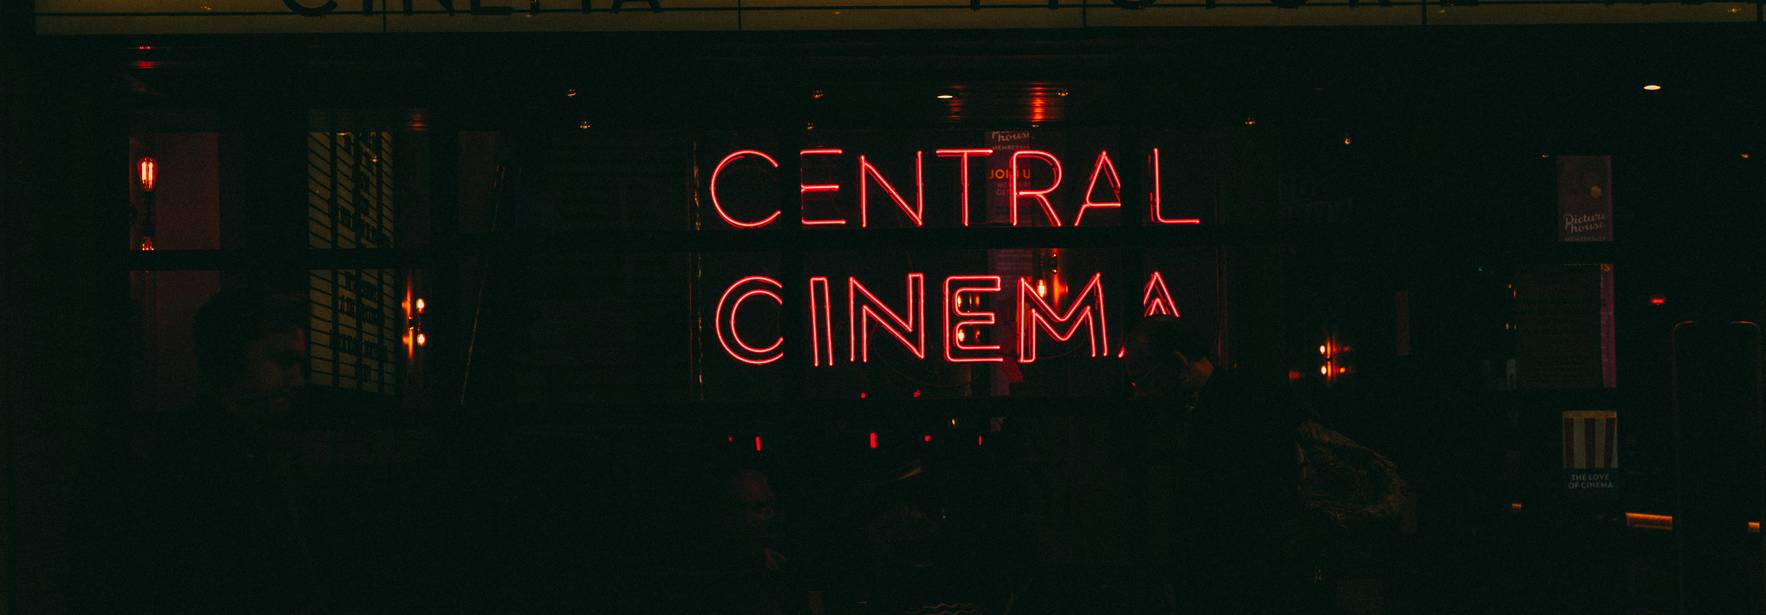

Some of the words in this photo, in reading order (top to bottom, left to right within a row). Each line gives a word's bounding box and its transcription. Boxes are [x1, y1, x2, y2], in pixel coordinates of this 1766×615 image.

[709, 147, 1201, 229] CENTRAL
[1571, 473, 1586, 481] THE
[1588, 473, 1609, 481] LOVE
[1568, 481, 1579, 489] OF
[1581, 481, 1613, 489] CINEMA
